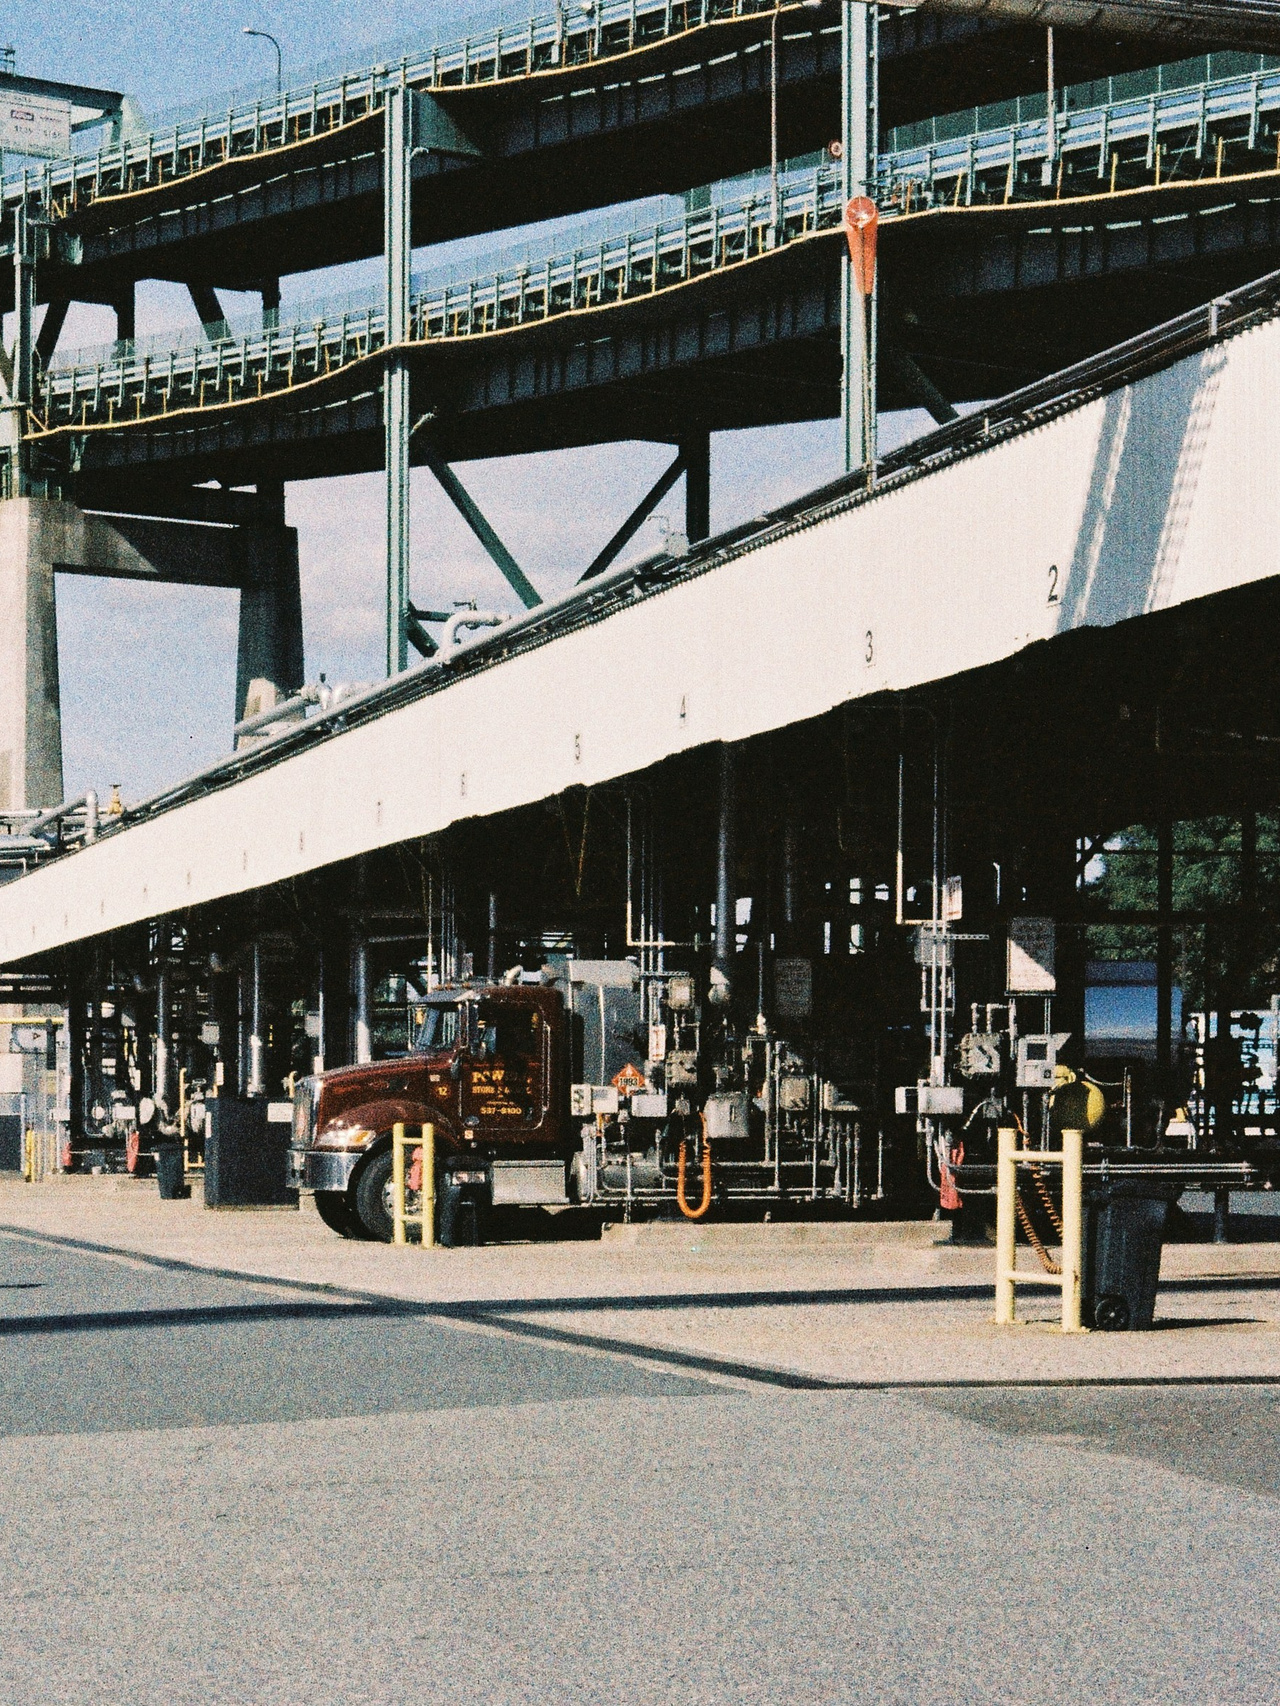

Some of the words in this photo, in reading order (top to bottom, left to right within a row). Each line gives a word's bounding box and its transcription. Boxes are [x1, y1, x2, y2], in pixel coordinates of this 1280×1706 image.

[1048, 565, 1058, 603] 2
[865, 630, 873, 663] 3
[680, 695, 687, 724] 4
[575, 734, 581, 761] 5
[437, 1087, 448, 1096] 12
